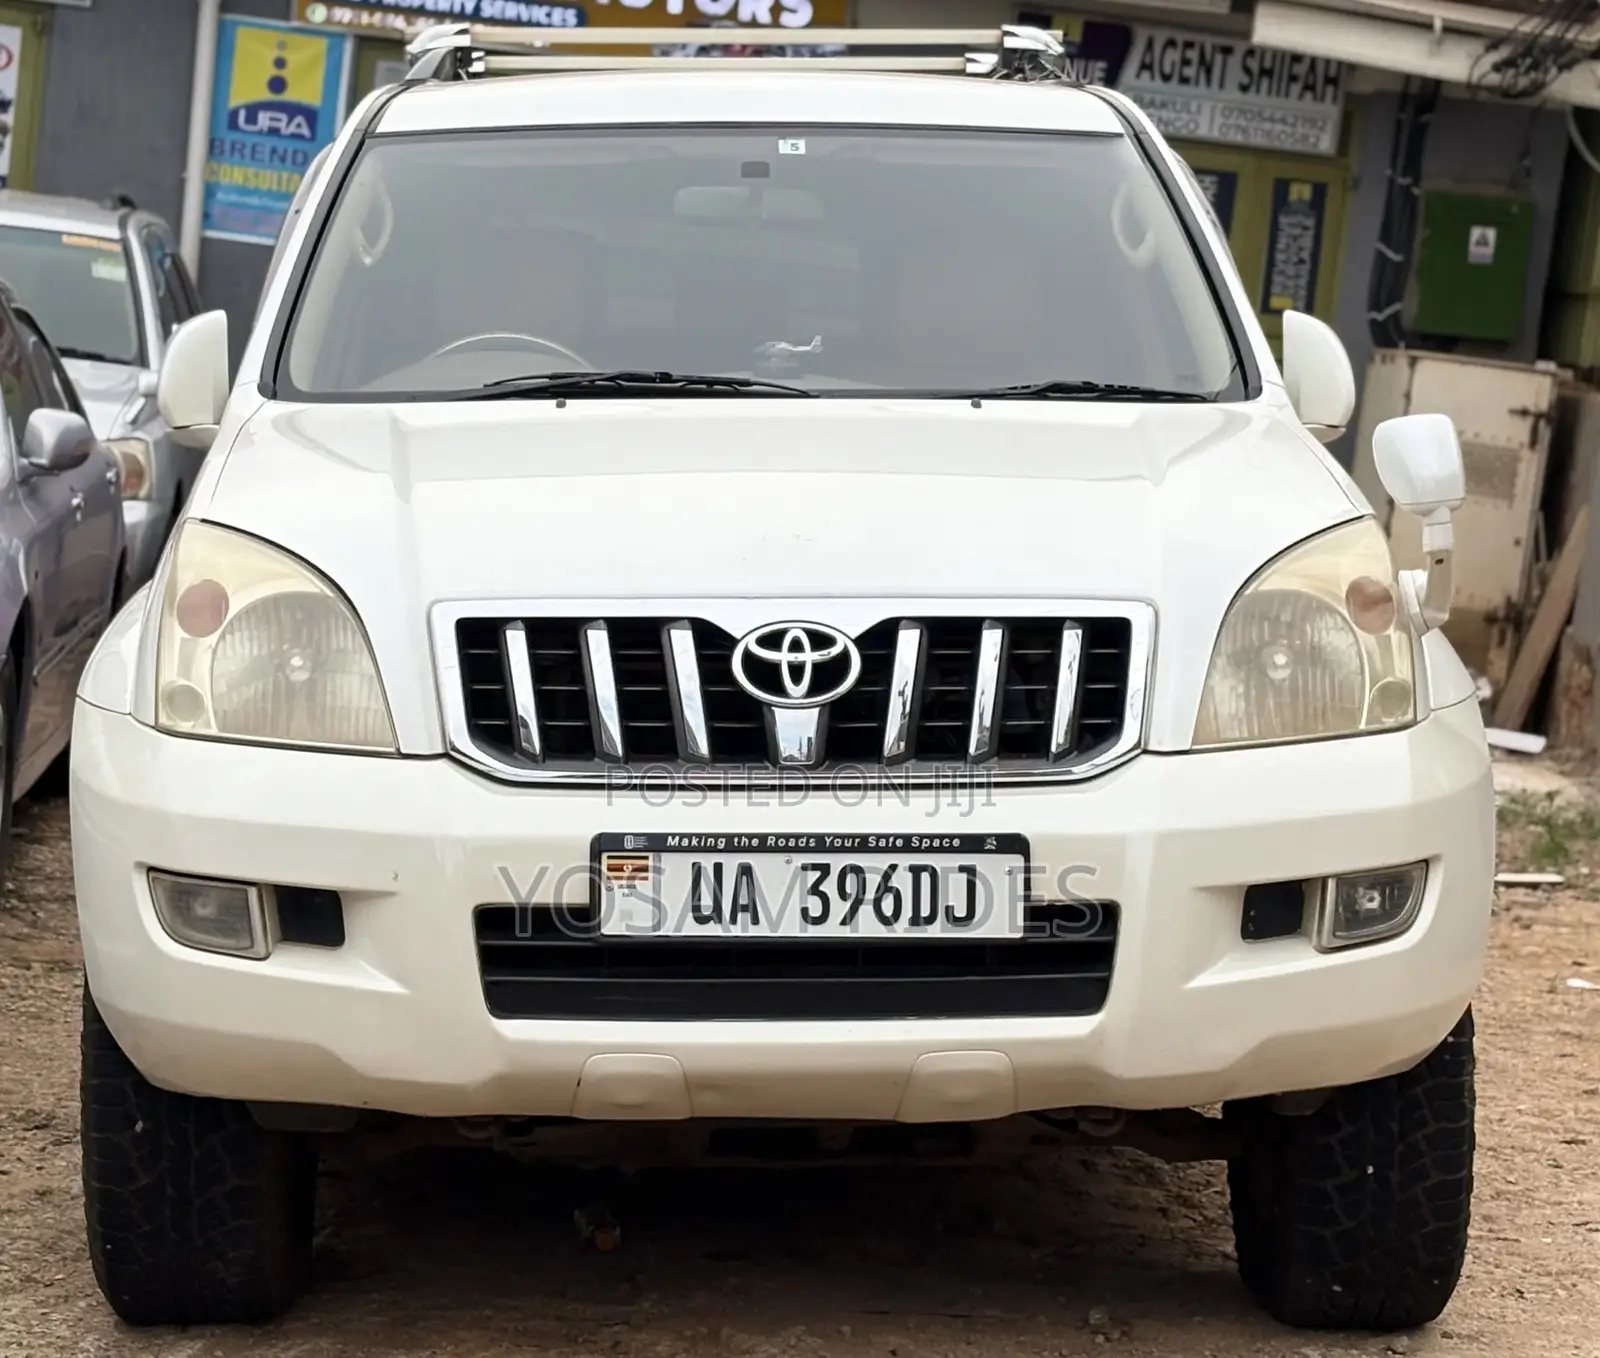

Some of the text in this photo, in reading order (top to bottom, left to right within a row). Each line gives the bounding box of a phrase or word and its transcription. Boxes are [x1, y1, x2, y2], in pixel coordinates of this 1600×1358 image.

[480, 0, 578, 27] SERVICES
[1136, 36, 1343, 104] AGENT SHIFAH
[237, 107, 312, 139] URA
[666, 835, 961, 849] Making the Roads Your Safe Space
[692, 861, 977, 927] UA 396DJ
